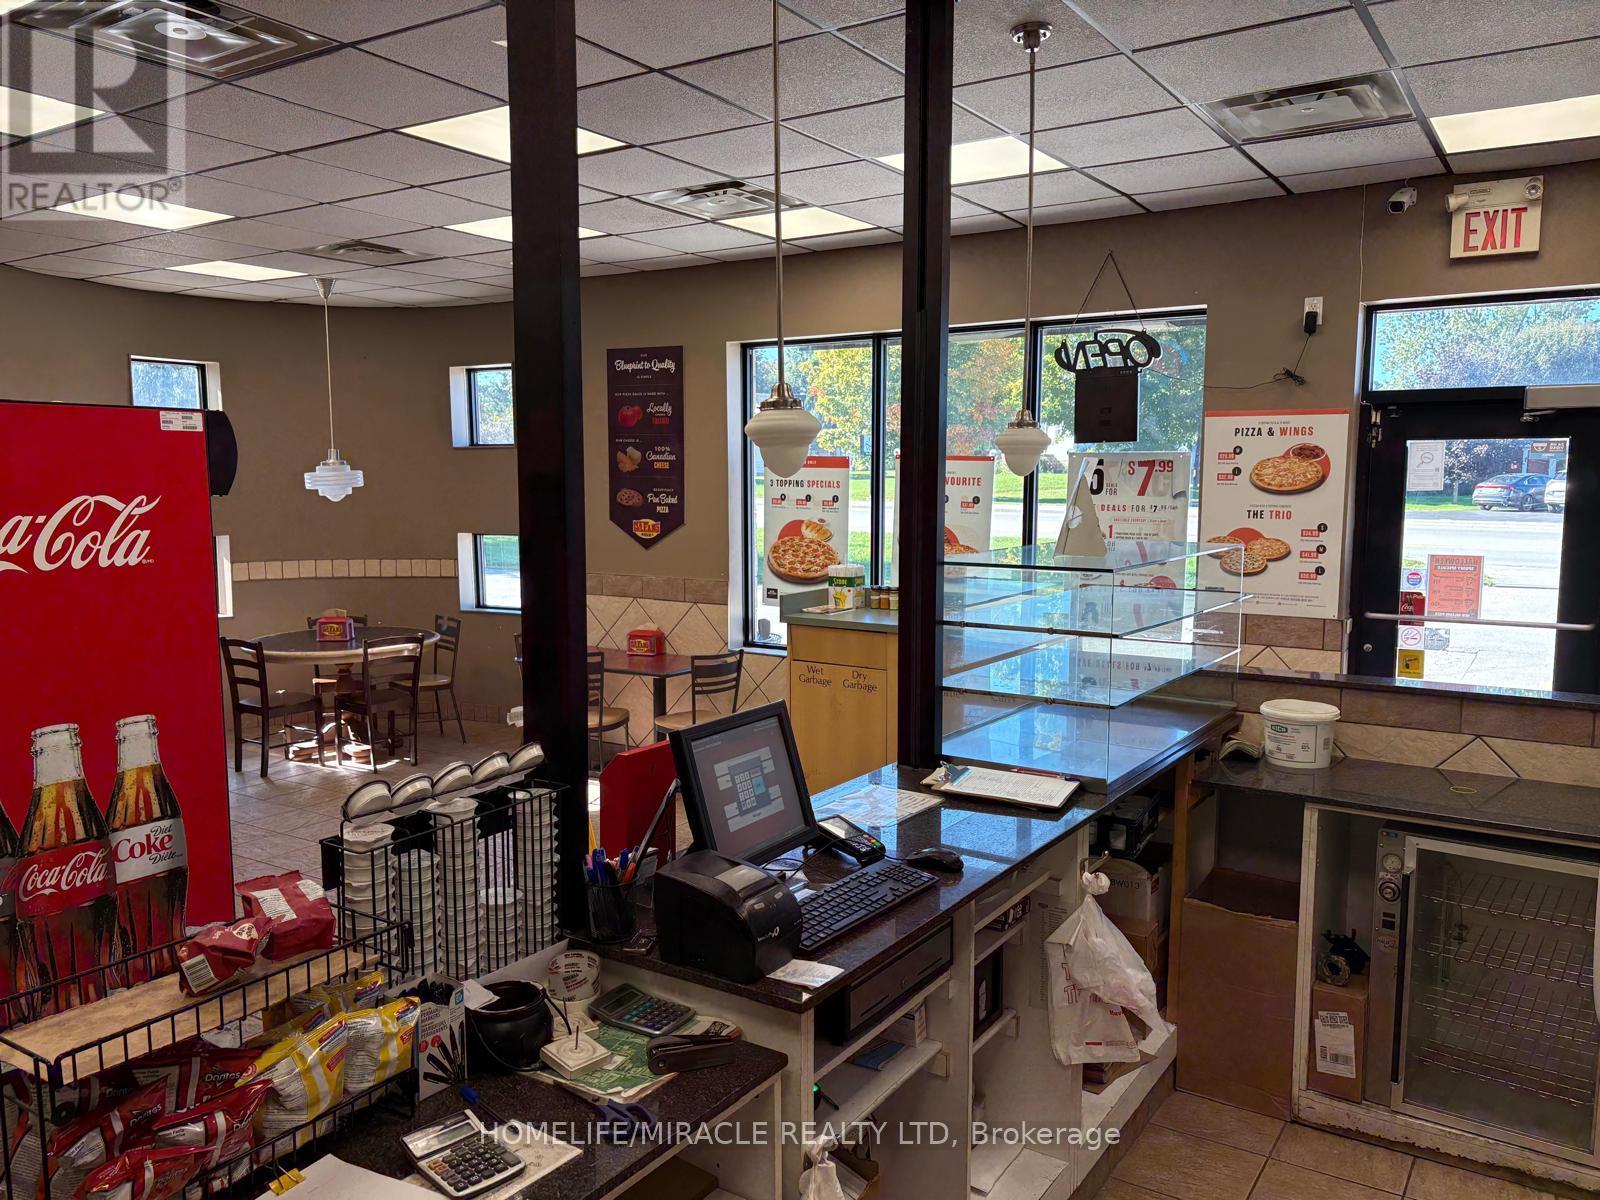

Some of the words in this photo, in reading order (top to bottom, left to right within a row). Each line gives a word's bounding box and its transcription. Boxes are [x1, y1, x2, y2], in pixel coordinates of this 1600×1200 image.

[1463, 207, 1528, 253] EXIT
[614, 359, 644, 373] Blueprint
[644, 360, 651, 369] to
[651, 358, 676, 373] Quality
[646, 401, 672, 417] Locally
[1234, 427, 1263, 437] PIZZA
[1267, 426, 1275, 436] &
[1279, 426, 1314, 436] WINGS
[645, 451, 677, 461] Canadian
[653, 461, 670, 469] CHEESE
[769, 479, 774, 487] 3
[776, 479, 804, 488] TOPPING
[807, 480, 841, 489] SPECIALS
[944, 476, 982, 486] VOURITE
[1127, 459, 1174, 497] $7.99
[1105, 488, 1118, 496] FOR
[647, 493, 660, 503] Pan
[660, 493, 678, 504] Baked
[1100, 503, 1127, 512] DEALS
[1131, 504, 1146, 513] FOR
[1246, 509, 1265, 520] THE
[1269, 510, 1292, 520] TRIO
[0, 494, 162, 574] a-Cola
[1108, 524, 1113, 539] 1
[806, 665, 824, 675] Wet
[851, 670, 868, 681] Dry
[798, 674, 832, 687] Garbage
[842, 679, 878, 693] Garbage
[150, 823, 173, 837] Diet
[114, 833, 173, 863] Coke
[18, 847, 111, 902] Coca-Cola
[204, 1071, 241, 1083] Doritos
